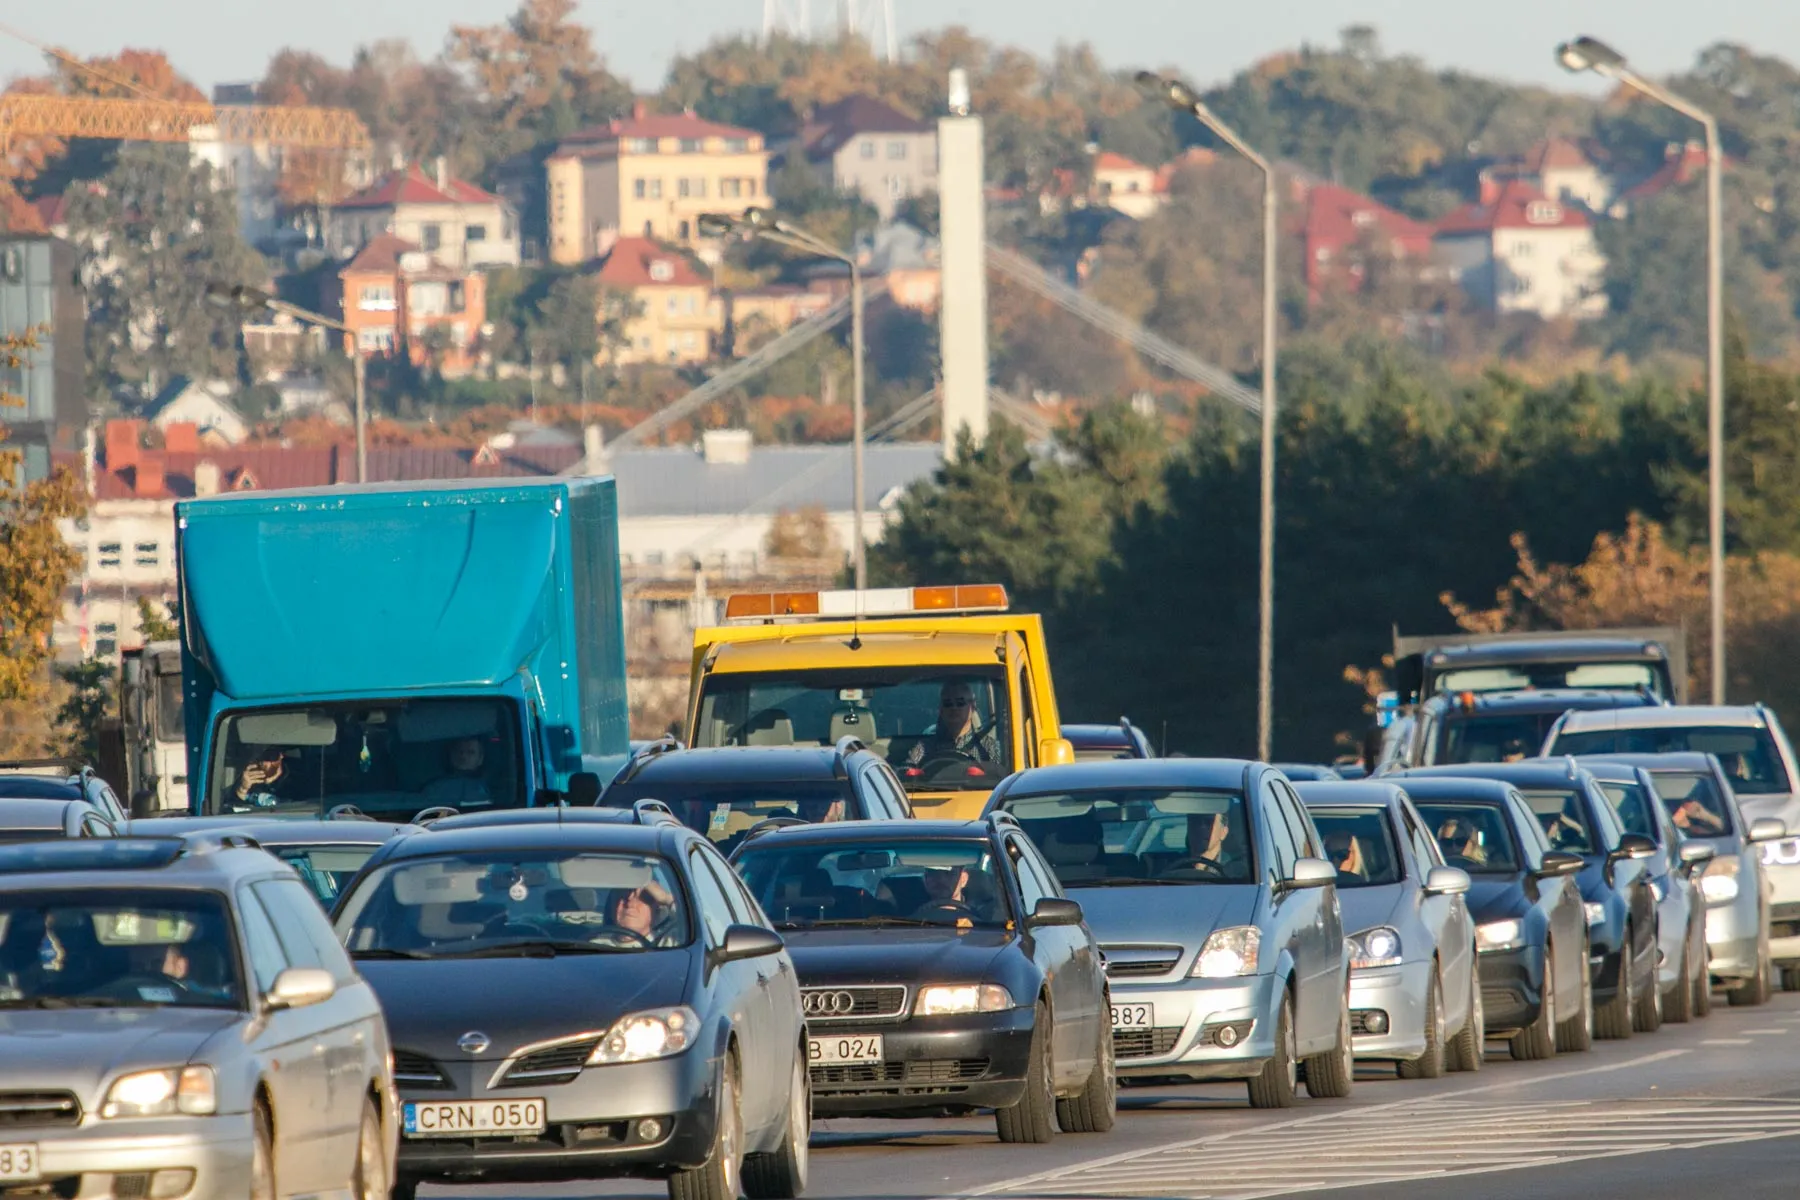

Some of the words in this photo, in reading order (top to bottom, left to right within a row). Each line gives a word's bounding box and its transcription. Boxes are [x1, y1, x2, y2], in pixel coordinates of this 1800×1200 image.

[838, 1039, 878, 1058] 024
[421, 1105, 475, 1129] CRN
[492, 1103, 538, 1126] 050
[0, 1149, 32, 1174] 83
